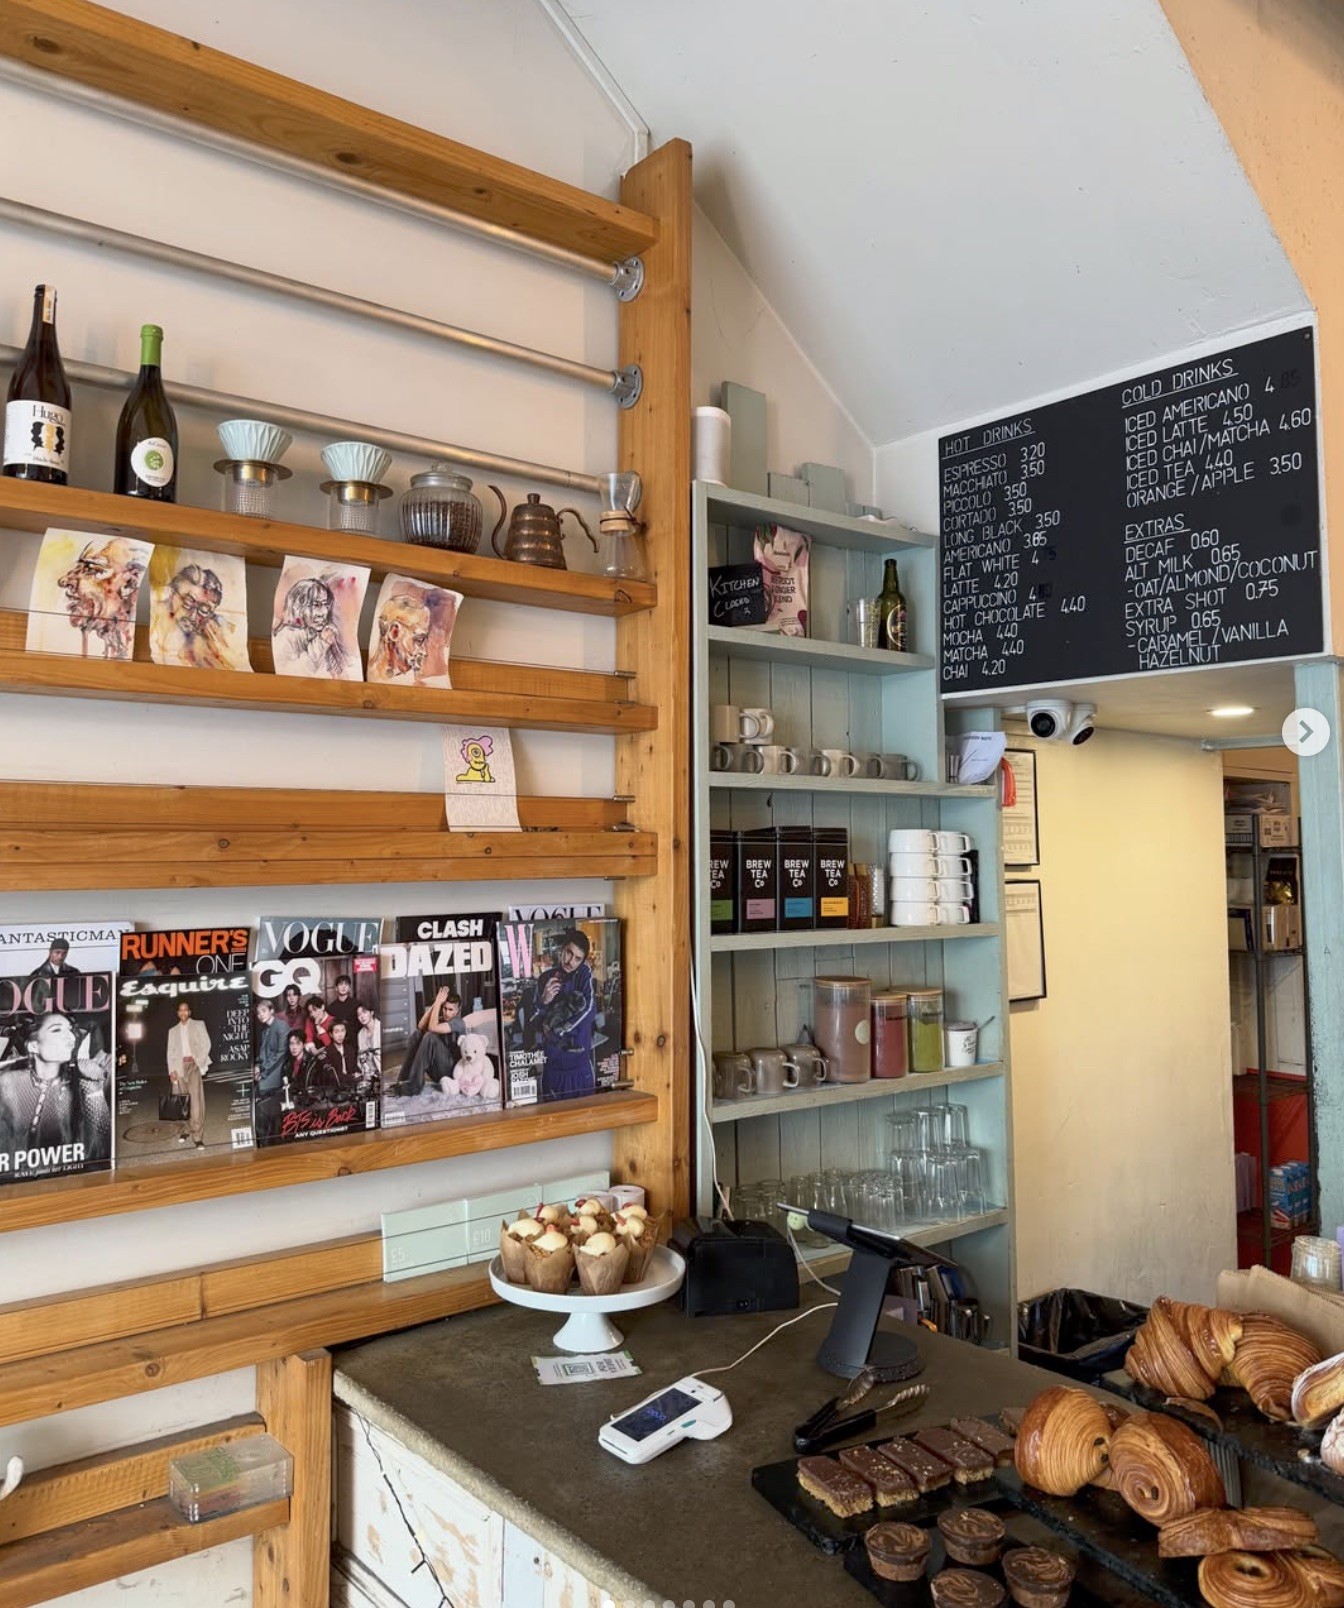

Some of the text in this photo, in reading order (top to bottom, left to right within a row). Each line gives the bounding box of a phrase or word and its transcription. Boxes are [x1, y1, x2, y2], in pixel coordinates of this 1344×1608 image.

[1121, 359, 1234, 406] COLD DRINKS
[1125, 411, 1156, 434] ICED
[1162, 383, 1250, 423] AMERICANO
[945, 418, 1032, 456] HOT DRINKS
[1125, 430, 1157, 452] ICED
[1162, 415, 1209, 443] LATTE
[1126, 450, 1158, 472] ICED
[1279, 407, 1312, 431] 4.60
[944, 453, 1007, 483] ESPRESSO
[1126, 469, 1159, 491] ICED
[1164, 460, 1195, 480] TEA
[1269, 452, 1302, 476] 3.50
[943, 470, 1008, 499] MACCHIATO
[943, 491, 992, 515] PICCOLO
[943, 507, 997, 532] CORTADO
[1125, 513, 1185, 541] EXTRAS
[944, 529, 975, 548] LONG
[982, 518, 1023, 541] BLACK
[943, 538, 1011, 564] AMERICANO
[1125, 538, 1175, 564] DECAF
[943, 562, 973, 582] FLAT
[981, 553, 1021, 574] WHITE
[1125, 562, 1149, 582] ALT
[1158, 553, 1194, 576] MILK
[709, 574, 760, 598] KITCHEN
[943, 578, 980, 598] LATTE
[1125, 579, 1280, 619] EXTRA SHOT 0.75
[943, 589, 1017, 614] CAPPUCCINO
[944, 613, 966, 631] HOT
[974, 602, 1046, 627] CHOCOLATE
[1125, 615, 1177, 637] SYRUP
[943, 629, 983, 647] MOCHA
[943, 645, 989, 664] MATCHA
[1139, 645, 1221, 670] HAZELNUT
[943, 663, 969, 681] CHAI
[710, 860, 730, 869] REW
[746, 859, 772, 869] BREW
[750, 869, 769, 879] TEA
[784, 859, 810, 869] BREW
[788, 869, 806, 878] TEA
[820, 859, 845, 869] BREW
[825, 869, 842, 878] TEA
[264, 921, 380, 954] VOGUE
[417, 919, 484, 940] CLASH
[121, 928, 248, 961] RUNNER'S
[504, 923, 535, 979] W
[380, 941, 493, 979] DAZED
[119, 975, 249, 998] Esquire
[251, 957, 322, 999] GQ
[0, 975, 110, 1018] OGUE
[14, 1143, 85, 1170] POWER
